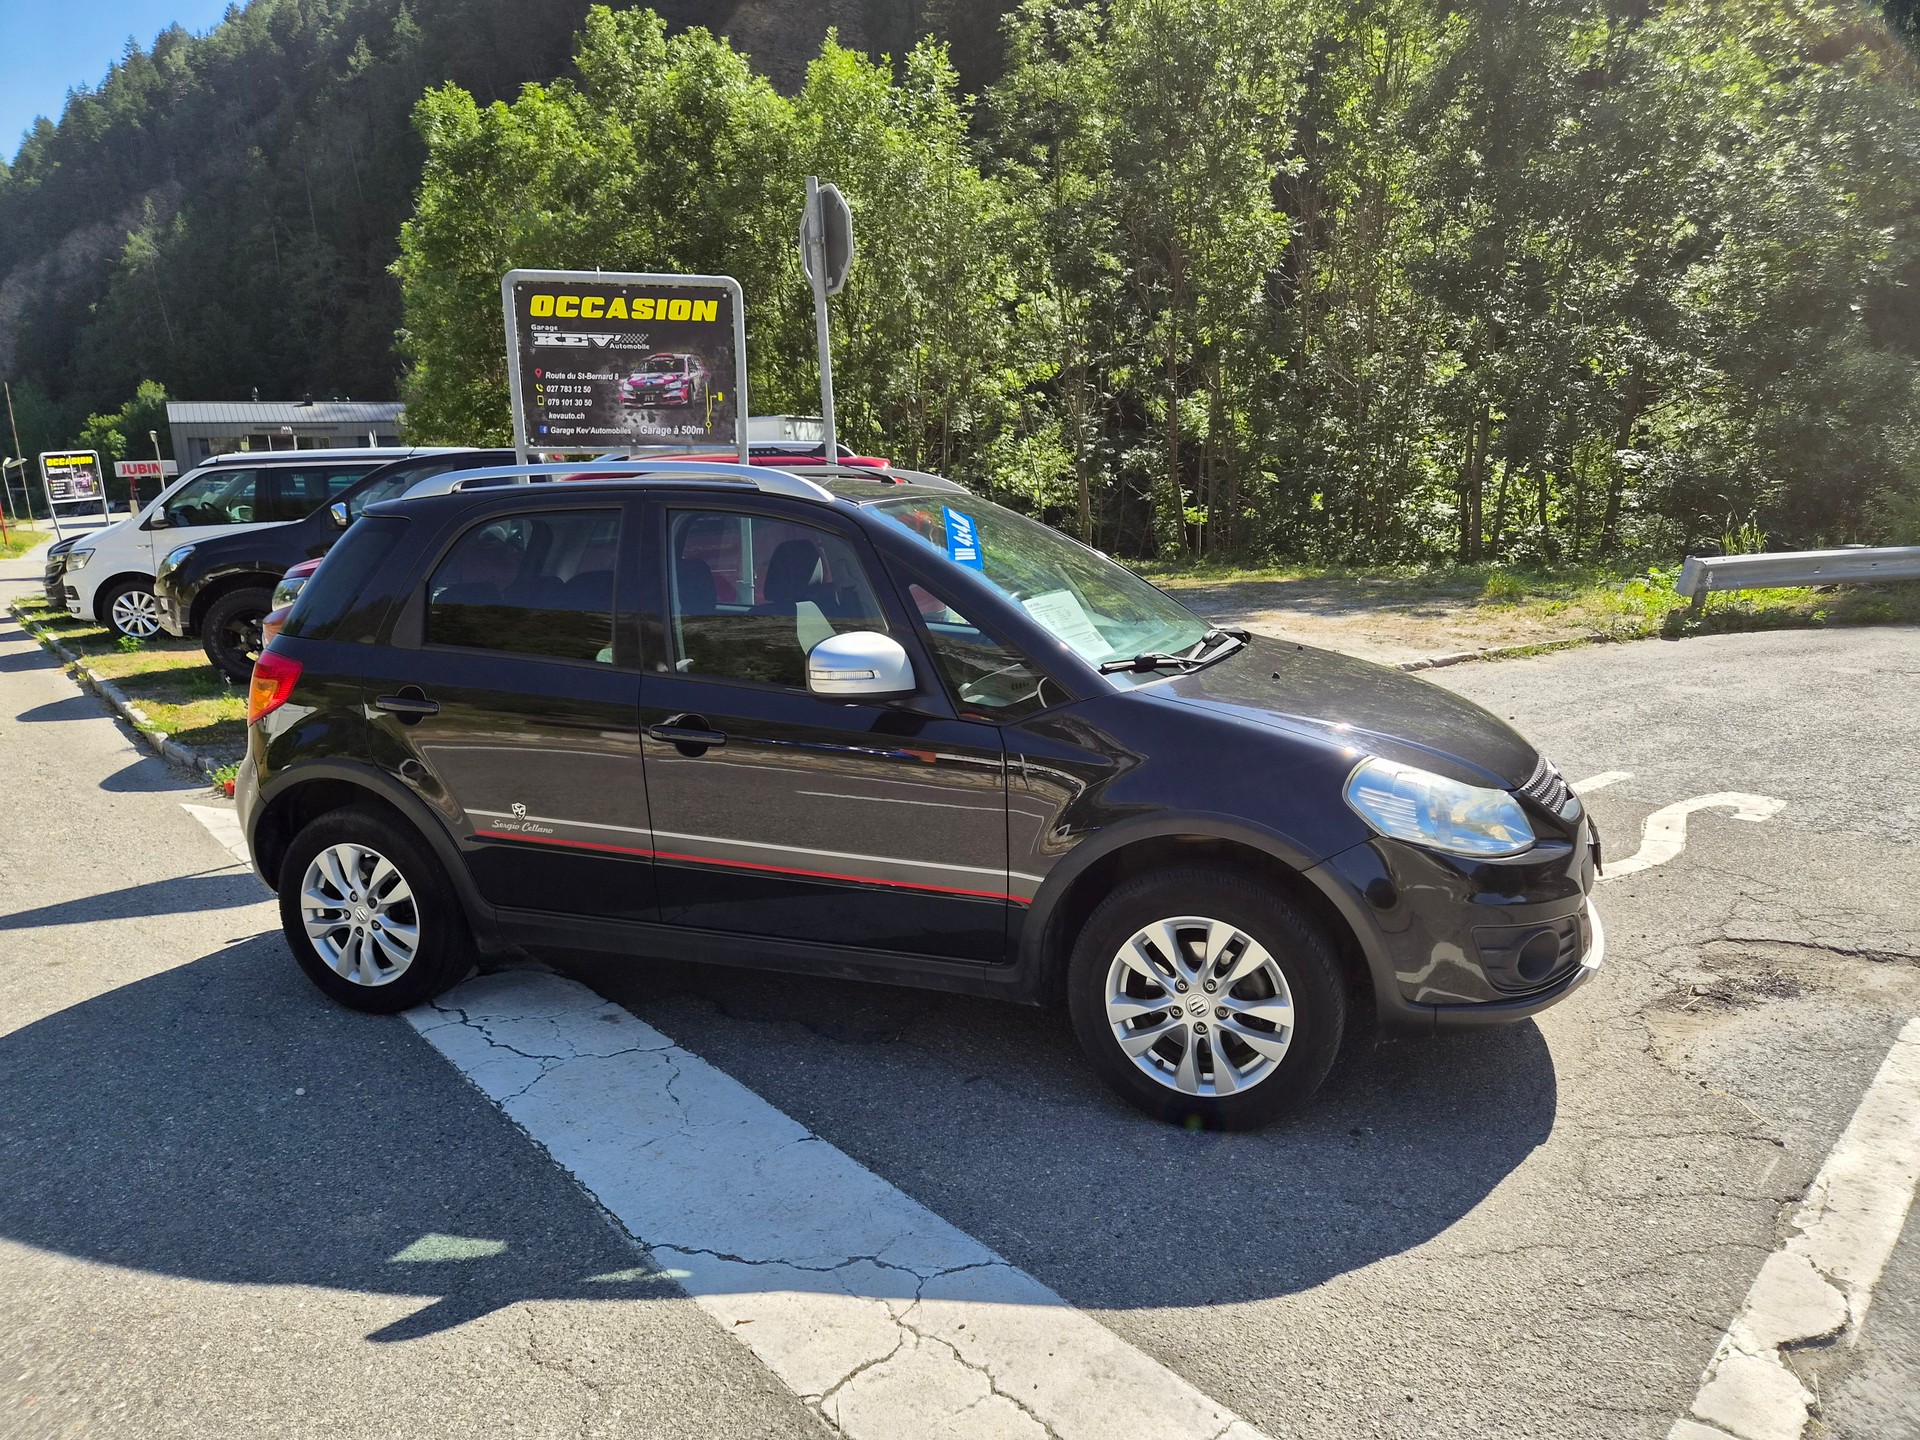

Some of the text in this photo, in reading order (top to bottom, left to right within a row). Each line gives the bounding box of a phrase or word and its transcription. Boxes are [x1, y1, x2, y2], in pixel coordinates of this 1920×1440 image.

[529, 294, 719, 323] OCCASION
[530, 323, 558, 332] Garage
[609, 342, 650, 350] Automobile
[545, 371, 566, 380] Route
[566, 371, 576, 380] du
[577, 372, 614, 380] St-Bernard
[546, 385, 592, 393] 027 783 12 50
[547, 398, 593, 406] 079 101 30 50
[548, 411, 586, 420] kevauto.ch
[550, 426, 632, 436] Garage Kev'Automobiles
[640, 424, 705, 437] Garage à 500m
[491, 819, 554, 834] Sergio Cellano
